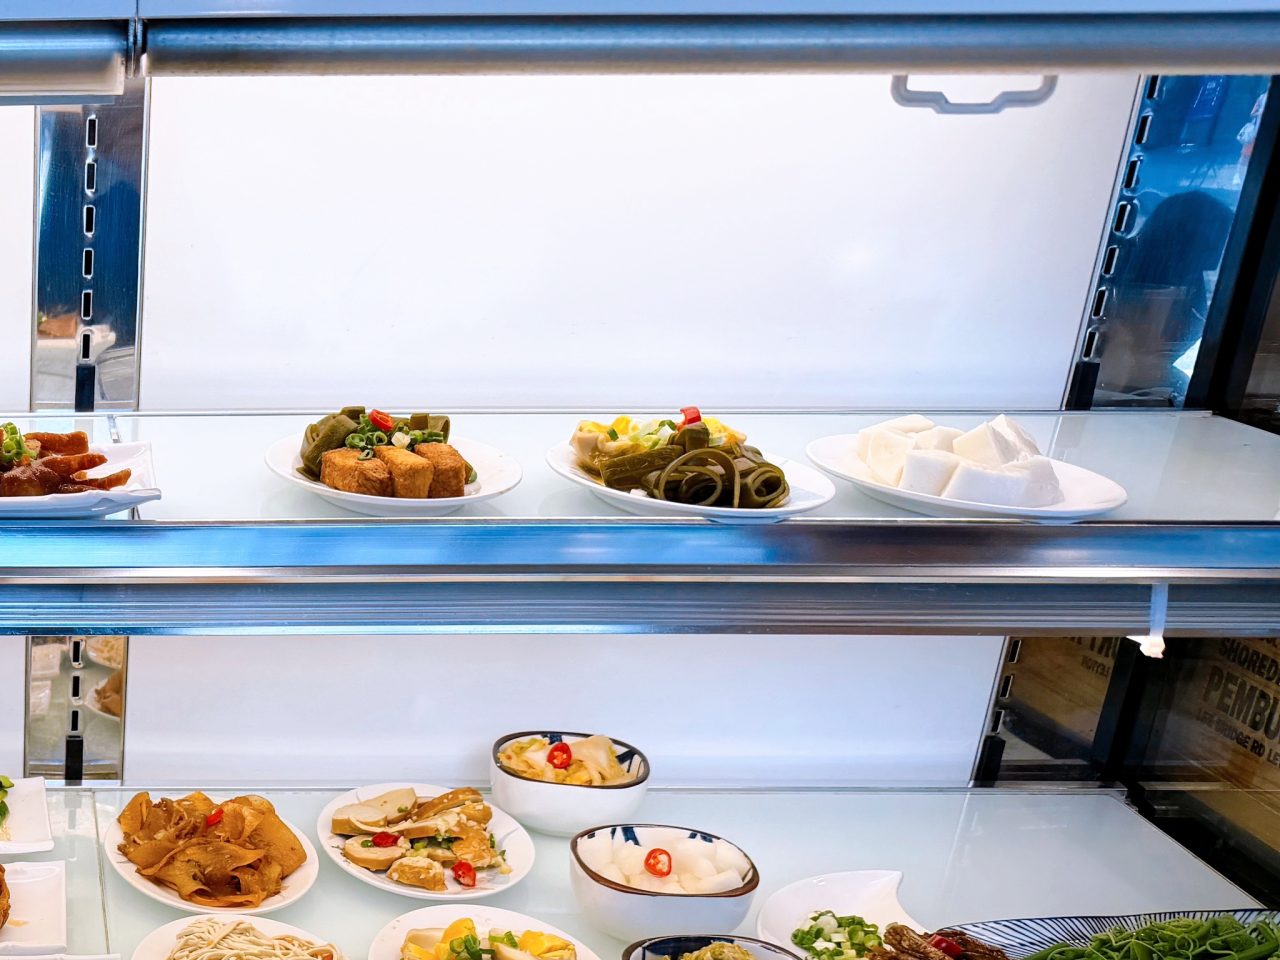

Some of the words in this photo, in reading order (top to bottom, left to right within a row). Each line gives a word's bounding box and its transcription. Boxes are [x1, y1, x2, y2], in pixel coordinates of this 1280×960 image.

[1219, 638, 1280, 686] SHORED
[1203, 665, 1280, 742] PEMBU
[1250, 739, 1265, 757] RD
[1267, 748, 1280, 768] LE
